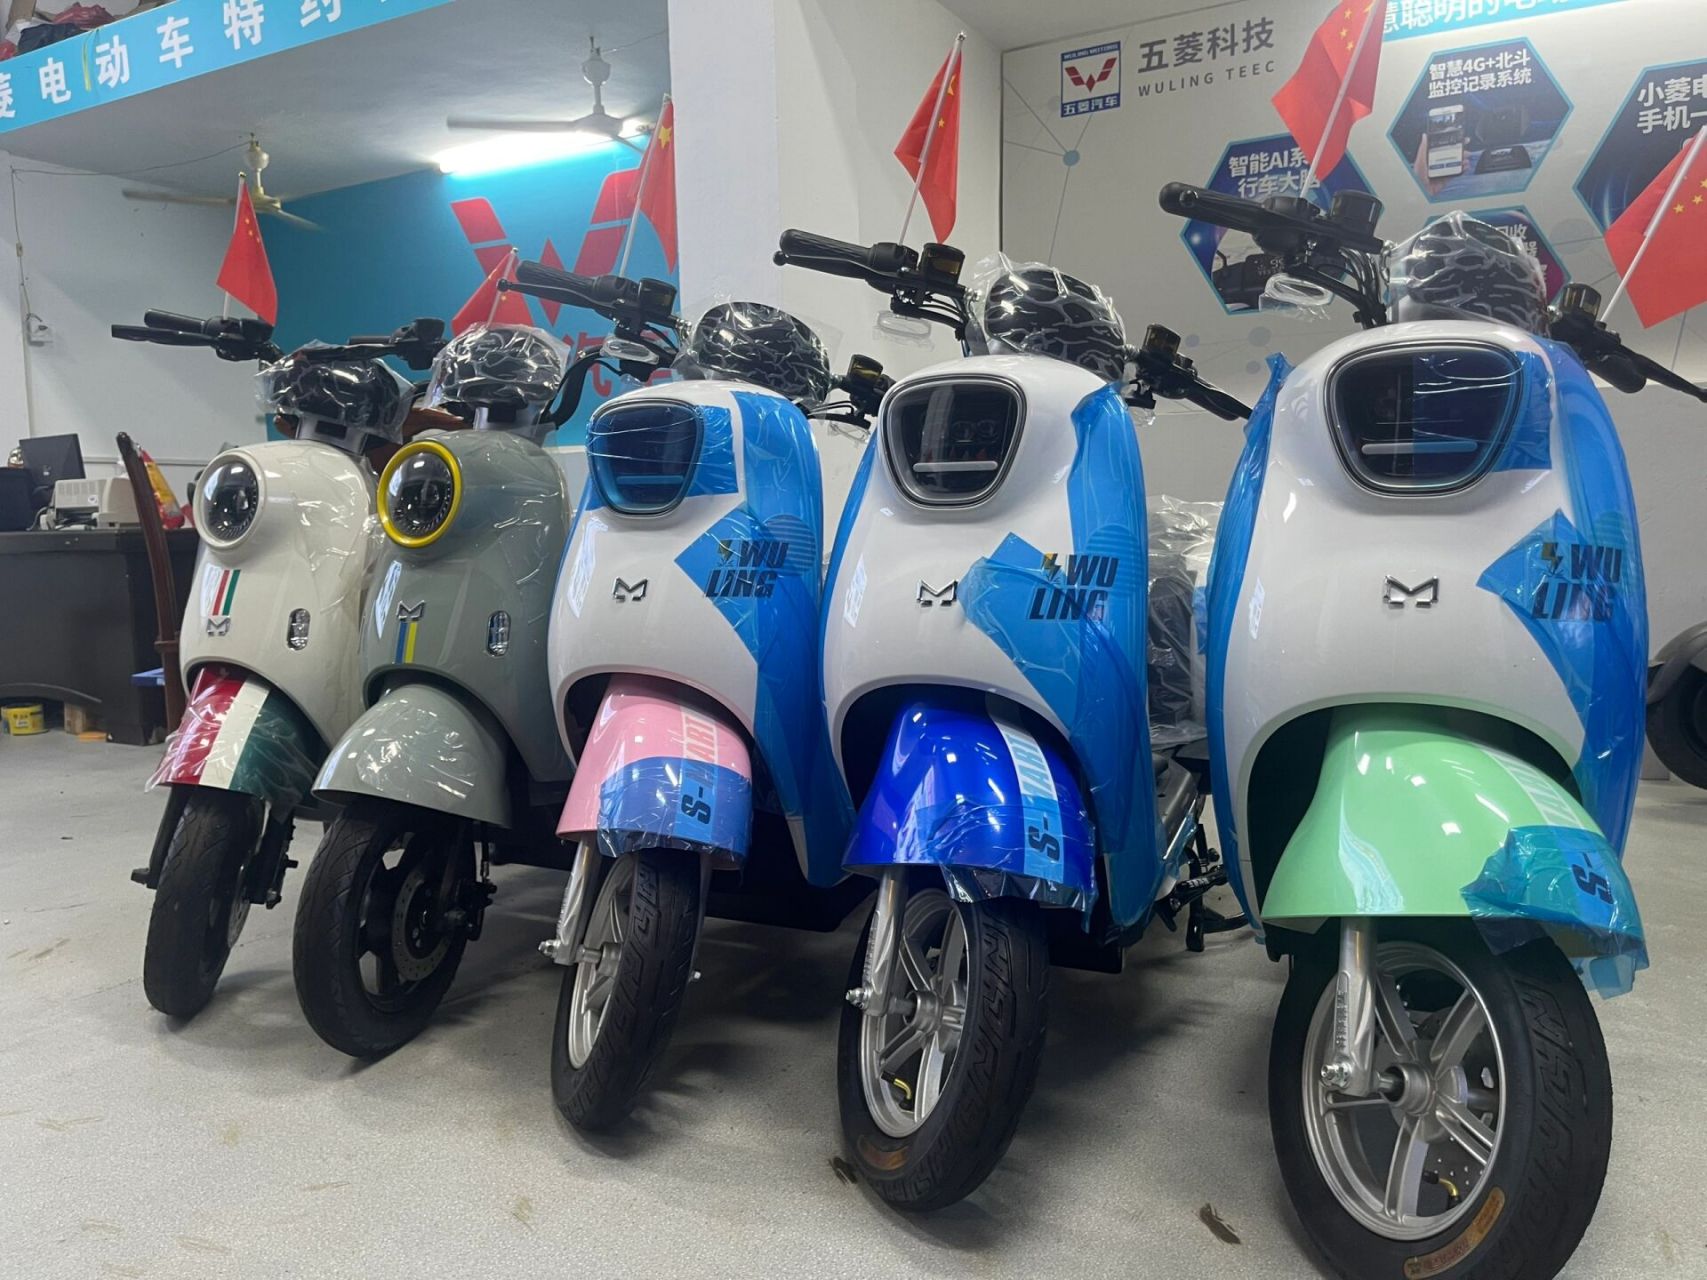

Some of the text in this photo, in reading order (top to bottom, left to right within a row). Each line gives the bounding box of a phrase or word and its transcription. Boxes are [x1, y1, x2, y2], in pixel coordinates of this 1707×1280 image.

[1137, 17, 1275, 73] 五菱科技
[1138, 60, 1275, 97] WULING TEEC
[1429, 48, 1531, 81] 智慧4G+北斗
[1428, 67, 1532, 99] 监控记录系统
[738, 540, 790, 569] WU
[1066, 554, 1119, 587] WU
[1571, 544, 1622, 584] WU
[705, 569, 778, 599] LING
